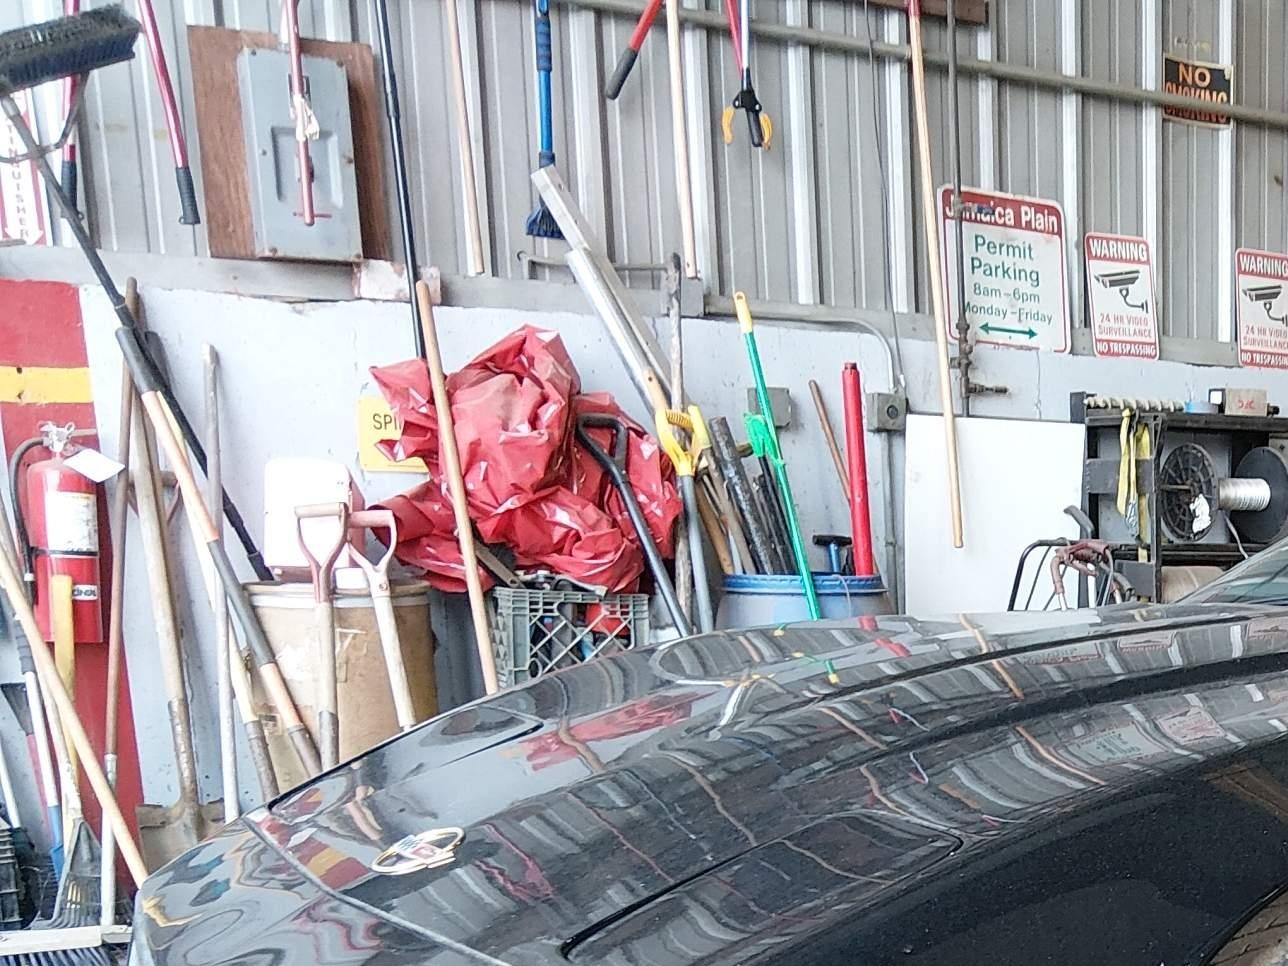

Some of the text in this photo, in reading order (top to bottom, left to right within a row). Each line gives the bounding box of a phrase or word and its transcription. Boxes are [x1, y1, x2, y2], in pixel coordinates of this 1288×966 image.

[1179, 63, 1211, 88] NO
[945, 194, 1058, 233] Jmaica Plain
[974, 234, 1034, 261] Permit
[1089, 239, 1147, 261] WARNING
[971, 257, 1040, 288] Parking
[1240, 254, 1288, 278] WARNING
[1098, 325, 1152, 339] SURVEILLANCE
[1096, 341, 1156, 355] NO TRESPASSING
[1241, 352, 1252, 362] NO
